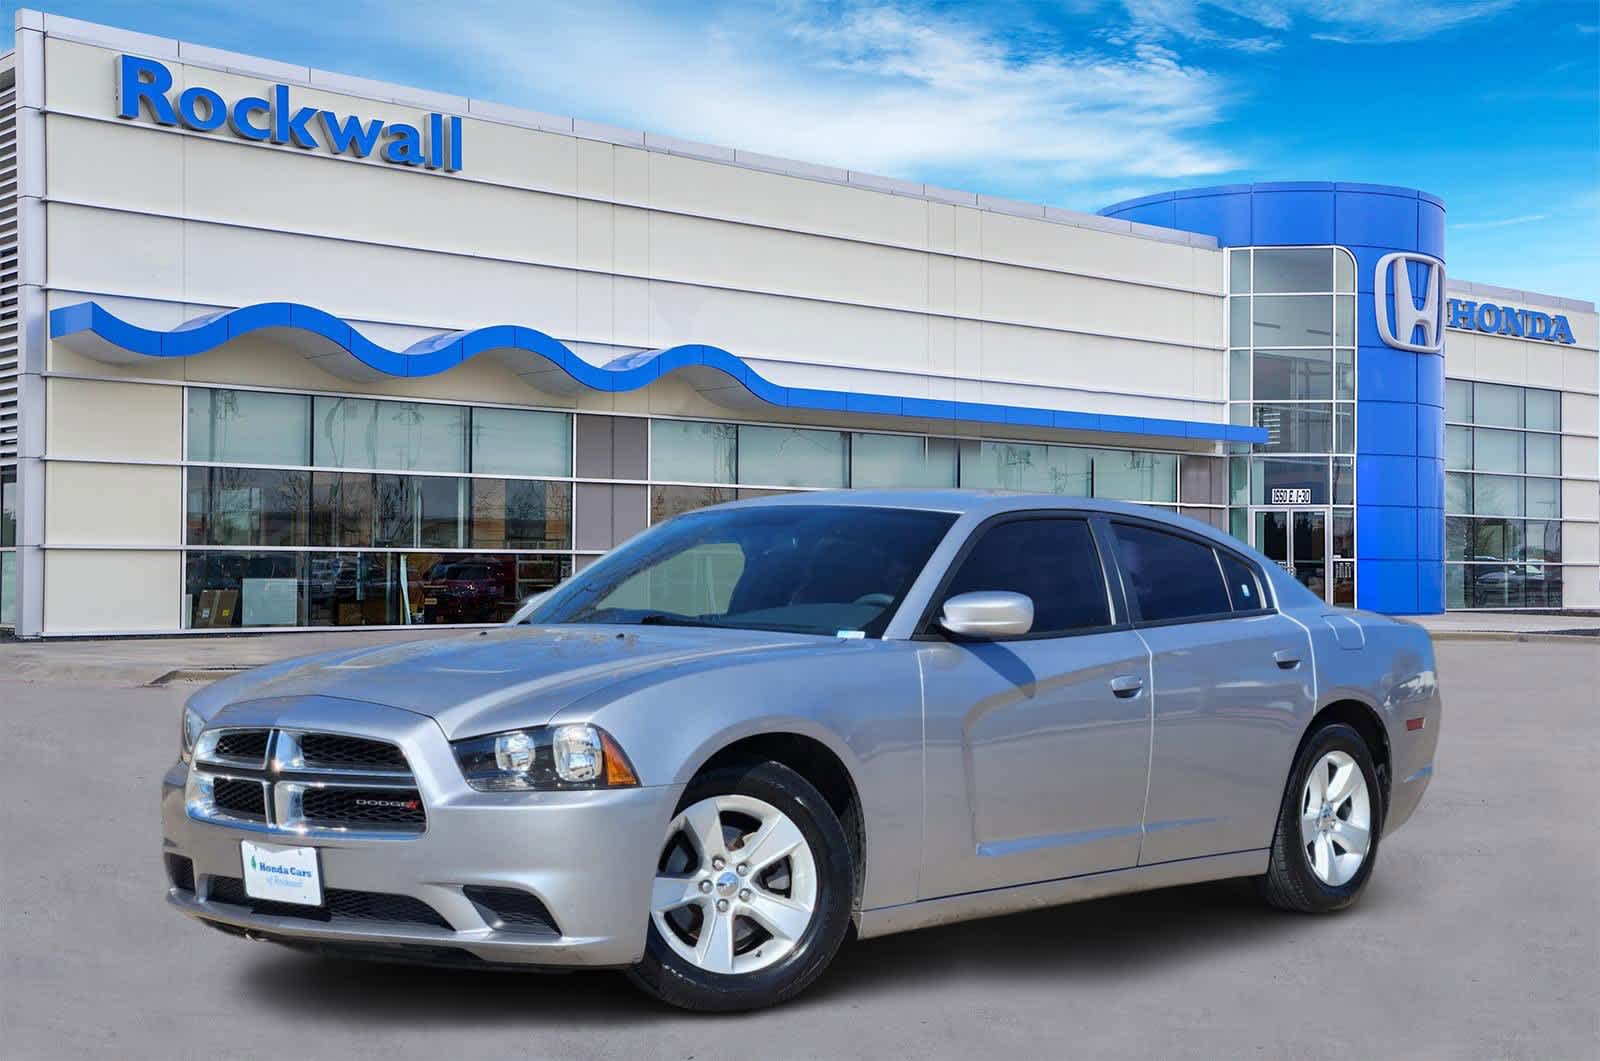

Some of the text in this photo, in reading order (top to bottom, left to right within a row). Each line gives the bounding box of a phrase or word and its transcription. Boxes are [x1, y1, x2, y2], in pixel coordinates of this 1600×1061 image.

[117, 54, 463, 172] Rockwall
[1447, 298, 1577, 345] HONDA
[356, 799, 408, 808] DODGE
[259, 862, 312, 878] Honda Cars
